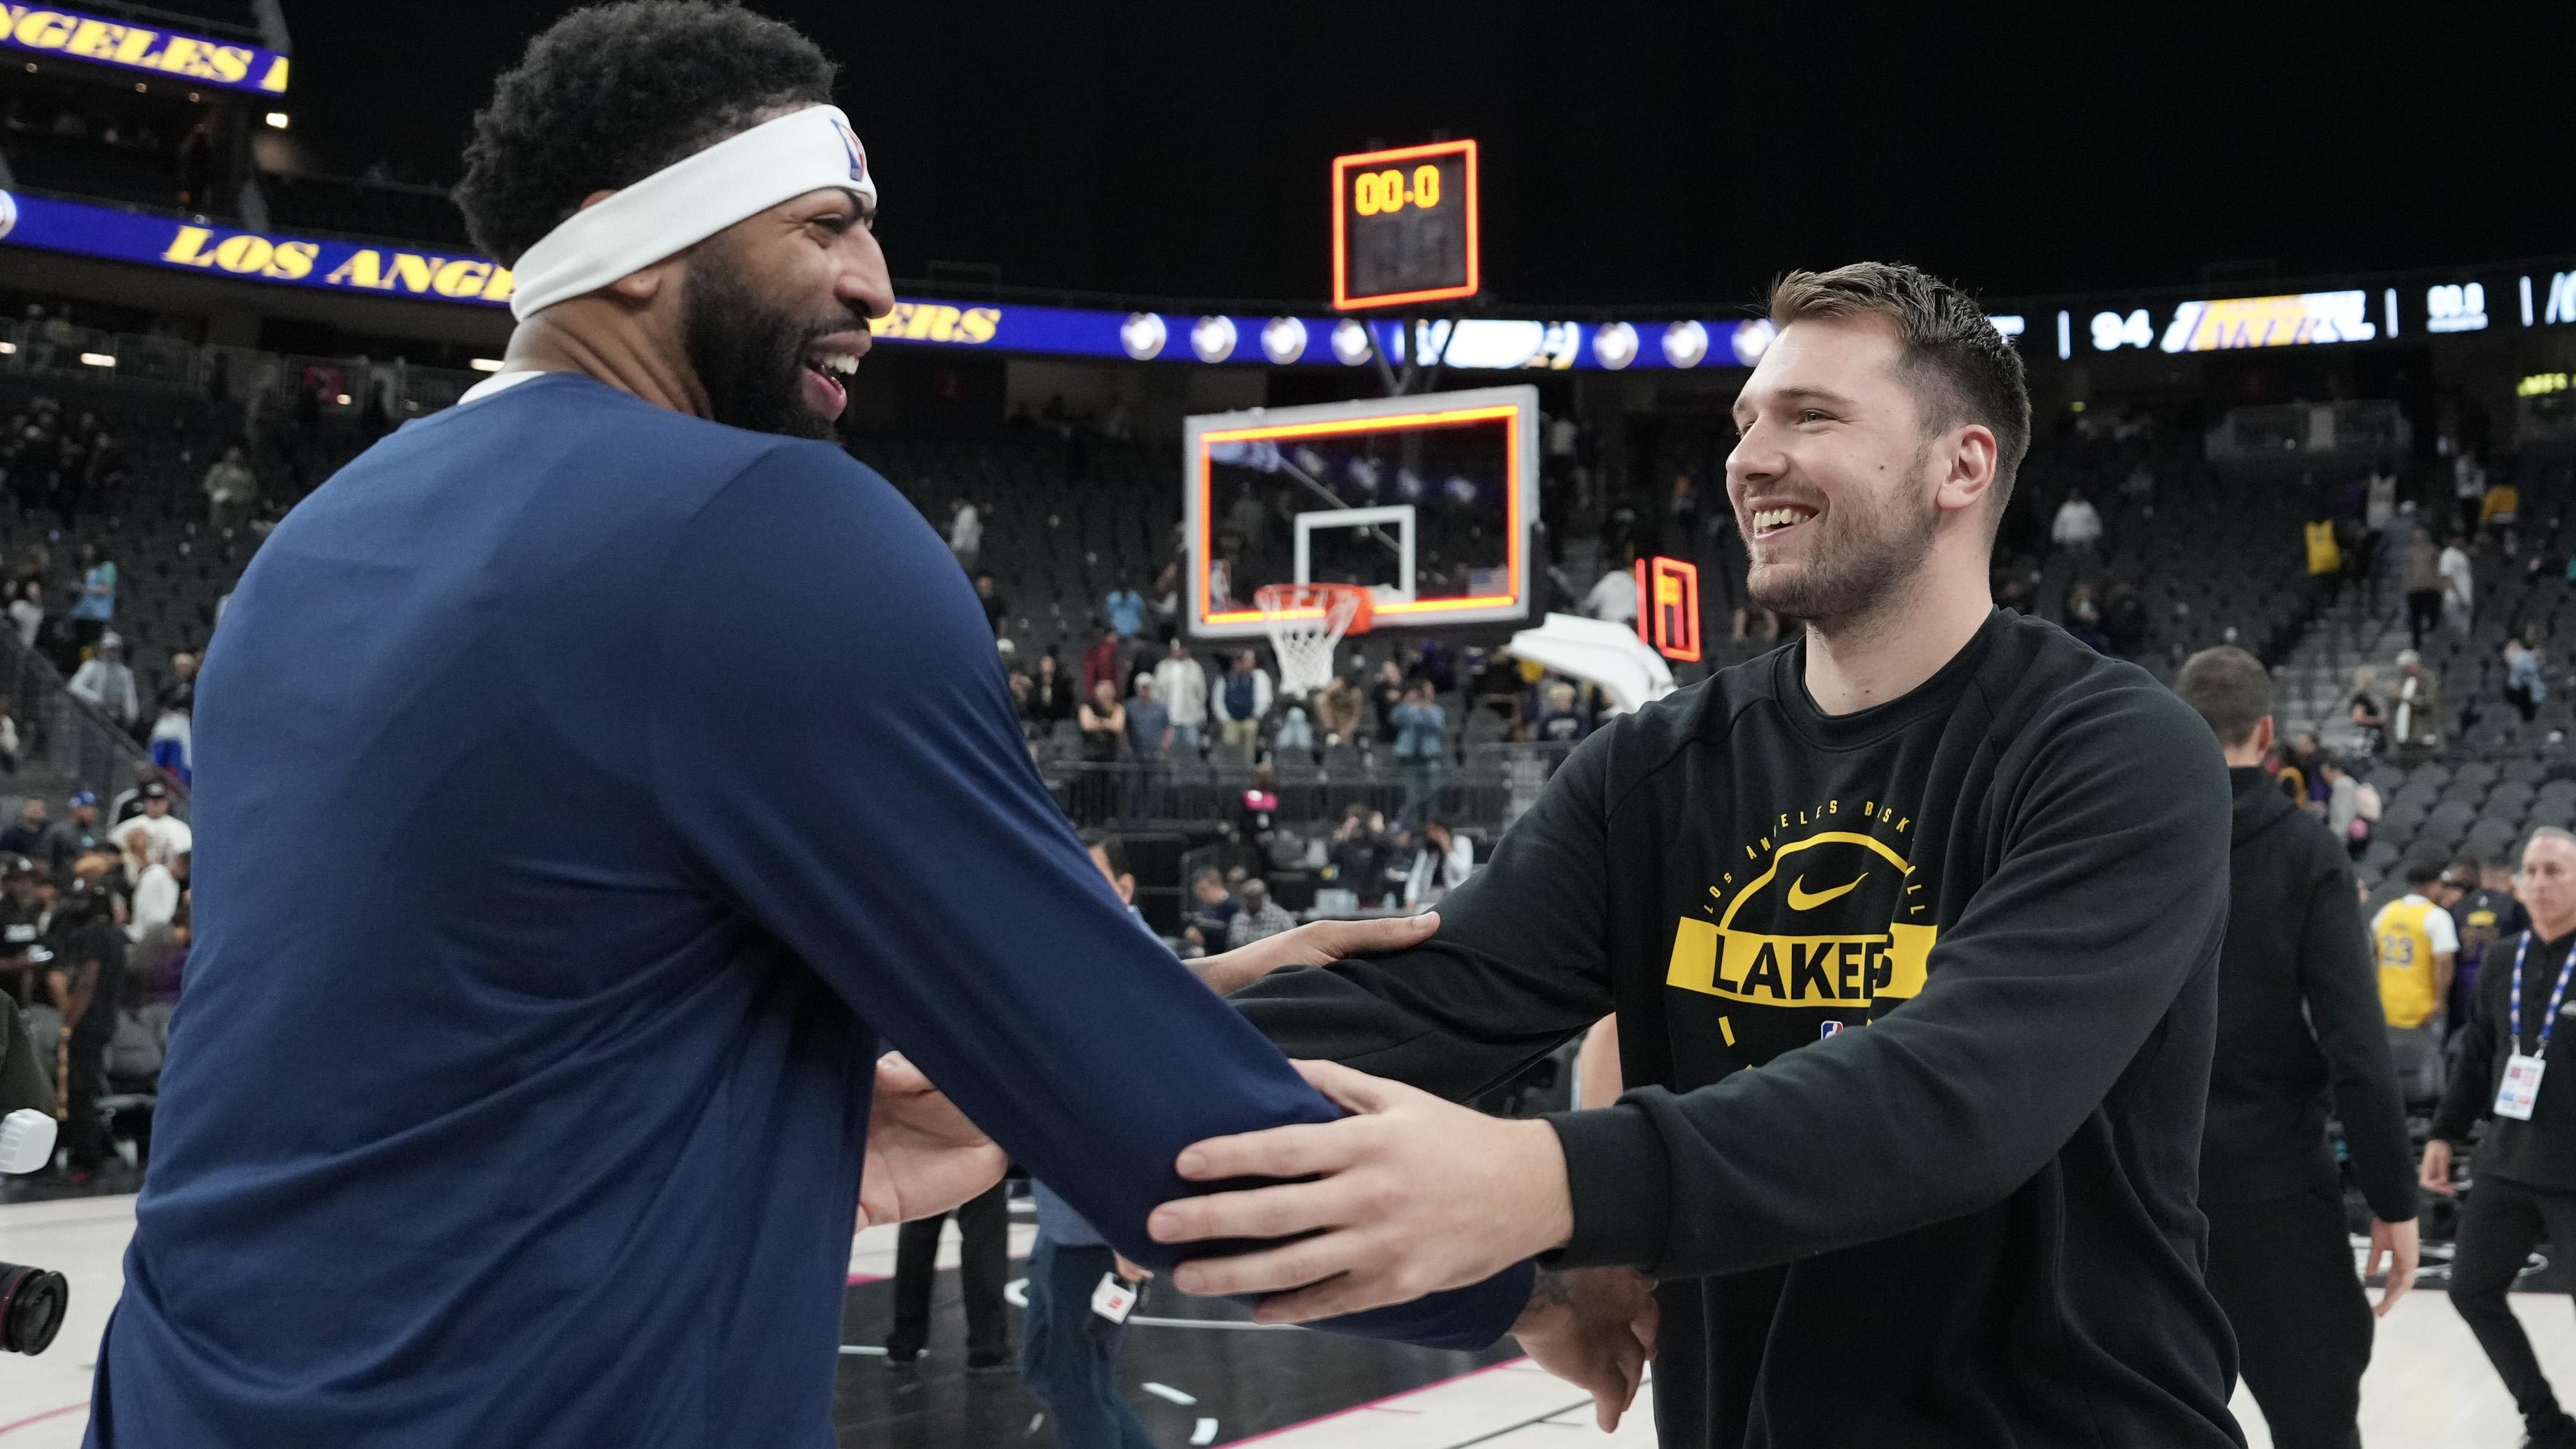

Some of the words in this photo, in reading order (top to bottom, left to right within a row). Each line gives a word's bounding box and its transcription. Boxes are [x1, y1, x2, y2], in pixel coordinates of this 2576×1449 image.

[160, 225, 320, 280] LOS
[2090, 308, 2154, 351] 94
[1703, 872, 1732, 915] LOS
[1745, 799, 1838, 860] ANELES
[2382, 935, 2415, 968] 23
